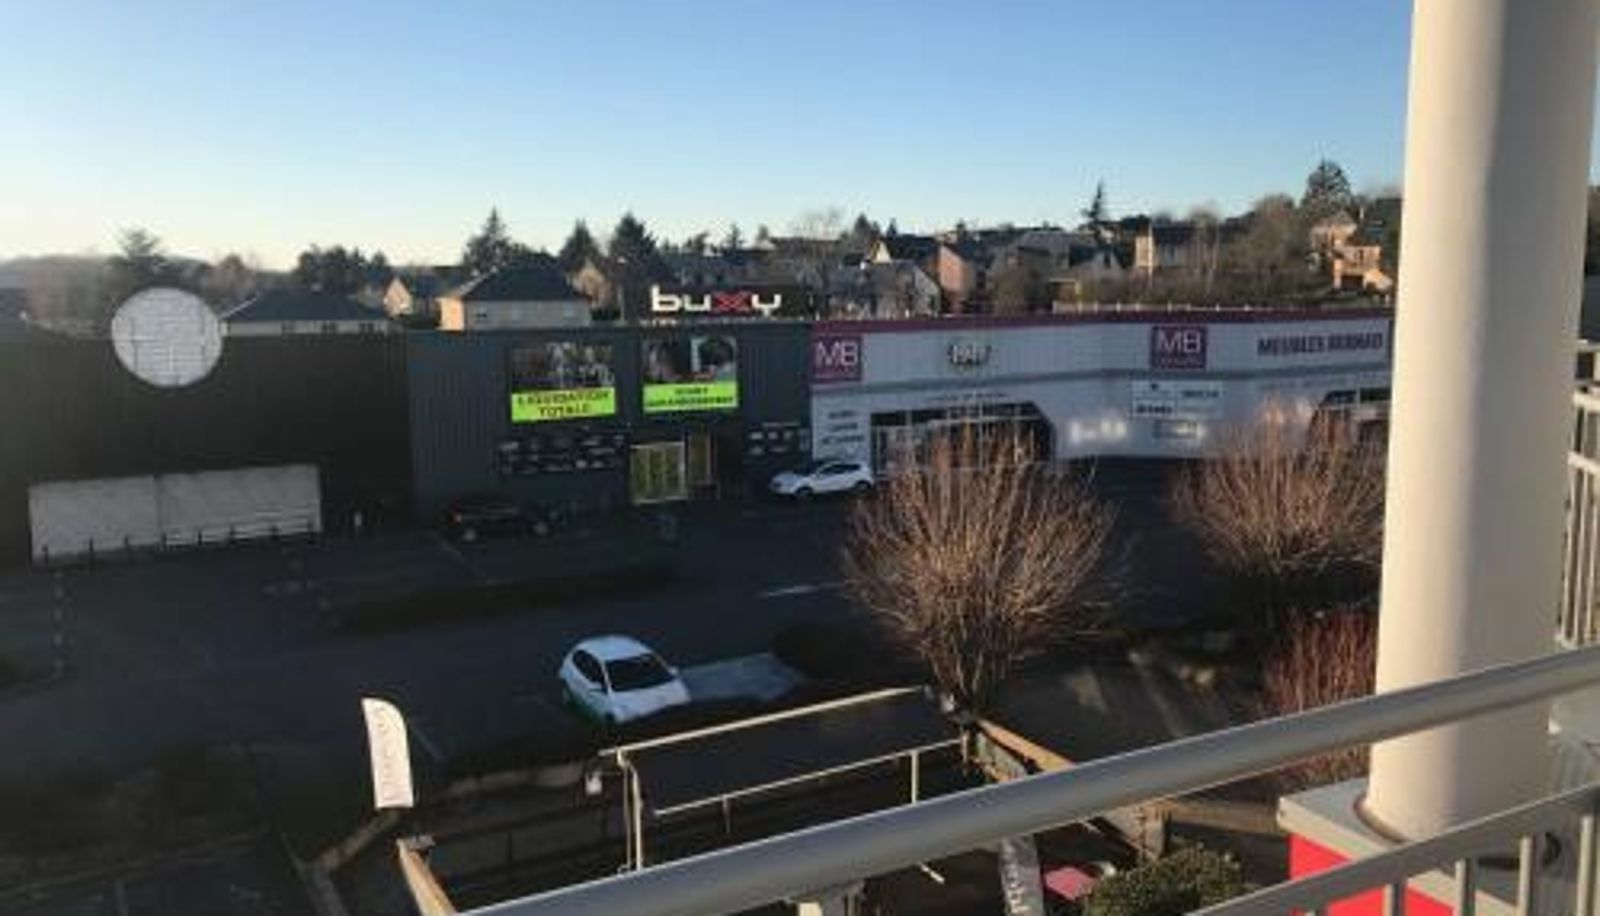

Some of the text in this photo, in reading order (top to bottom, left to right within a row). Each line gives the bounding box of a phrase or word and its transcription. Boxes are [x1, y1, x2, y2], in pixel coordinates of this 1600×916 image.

[651, 284, 782, 315] buxy
[814, 340, 858, 367] MB
[1157, 330, 1201, 353] MB
